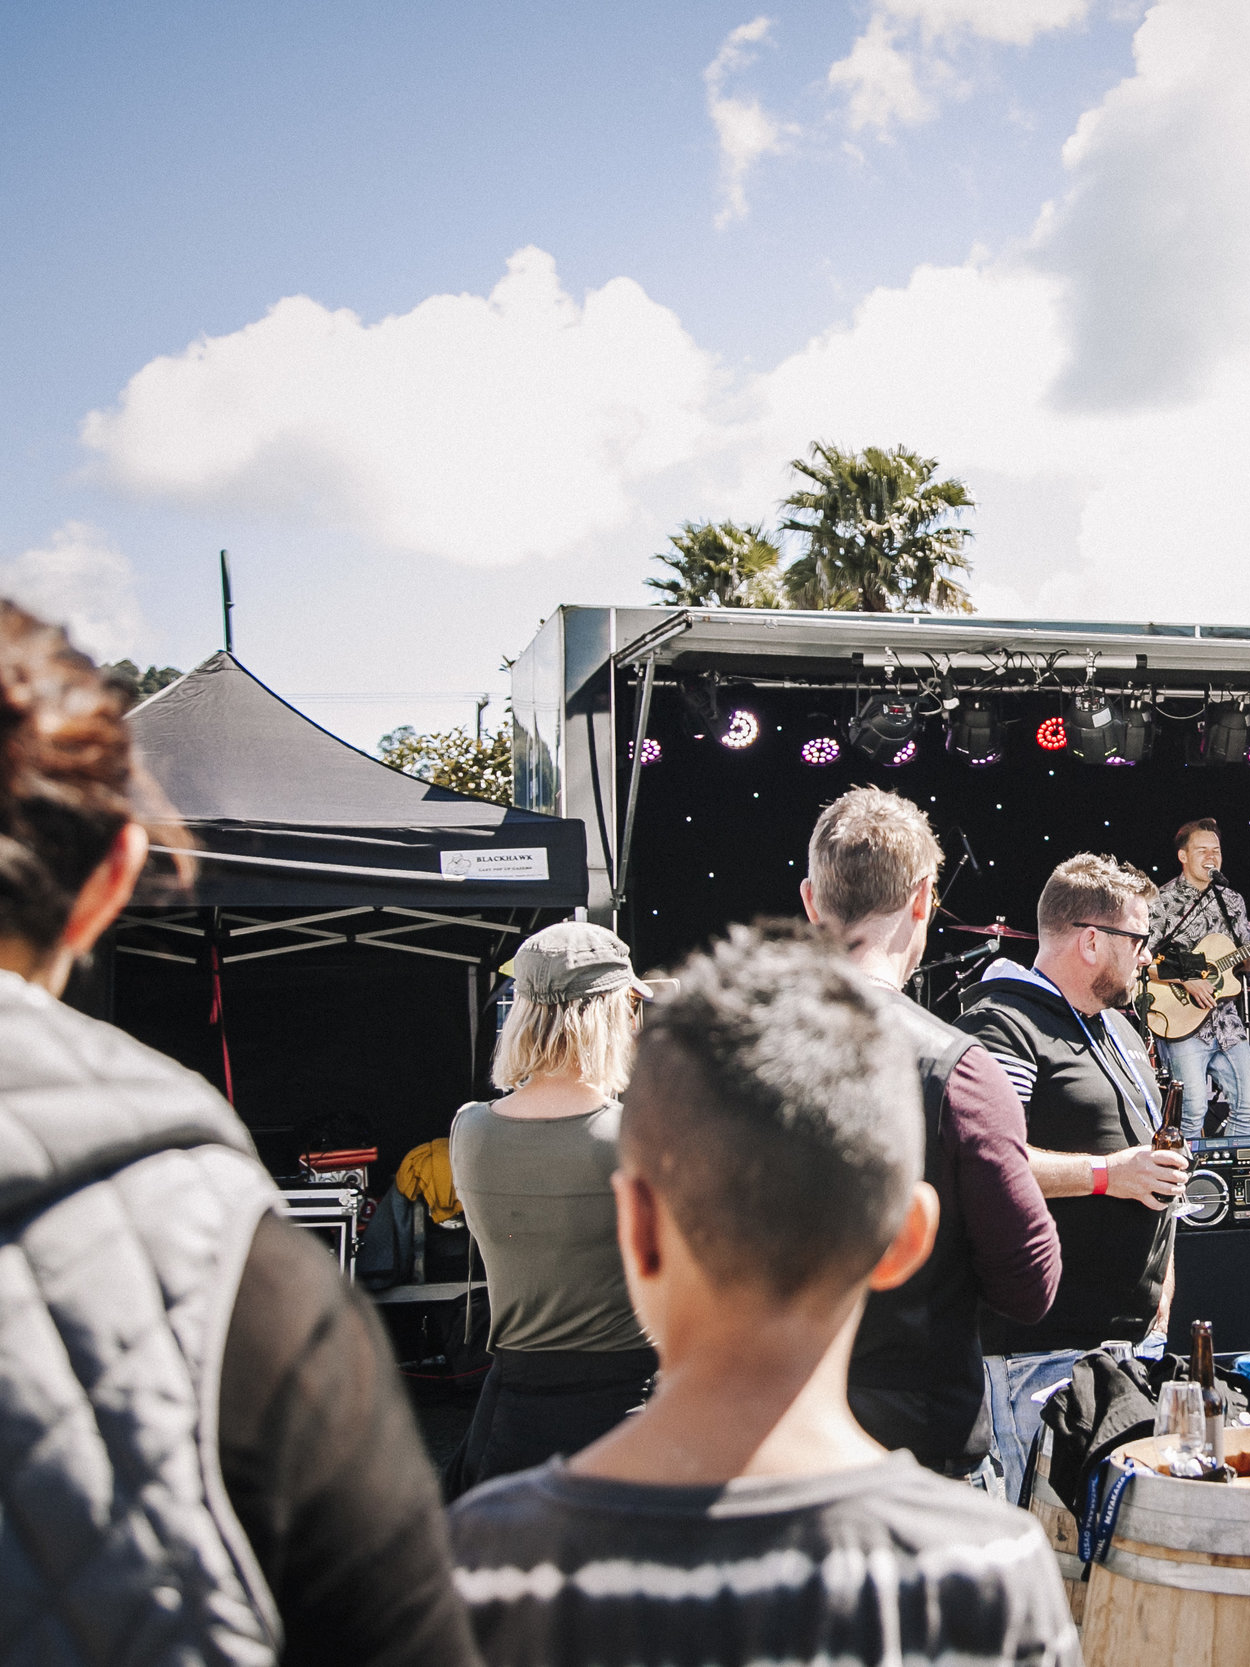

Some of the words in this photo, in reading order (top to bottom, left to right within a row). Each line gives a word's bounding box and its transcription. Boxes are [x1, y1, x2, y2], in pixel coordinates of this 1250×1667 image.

[476, 854, 533, 863] BLACKHAWK
[1103, 1476, 1126, 1525] MATAKANA
[1083, 1531, 1091, 1559] OYSTE
